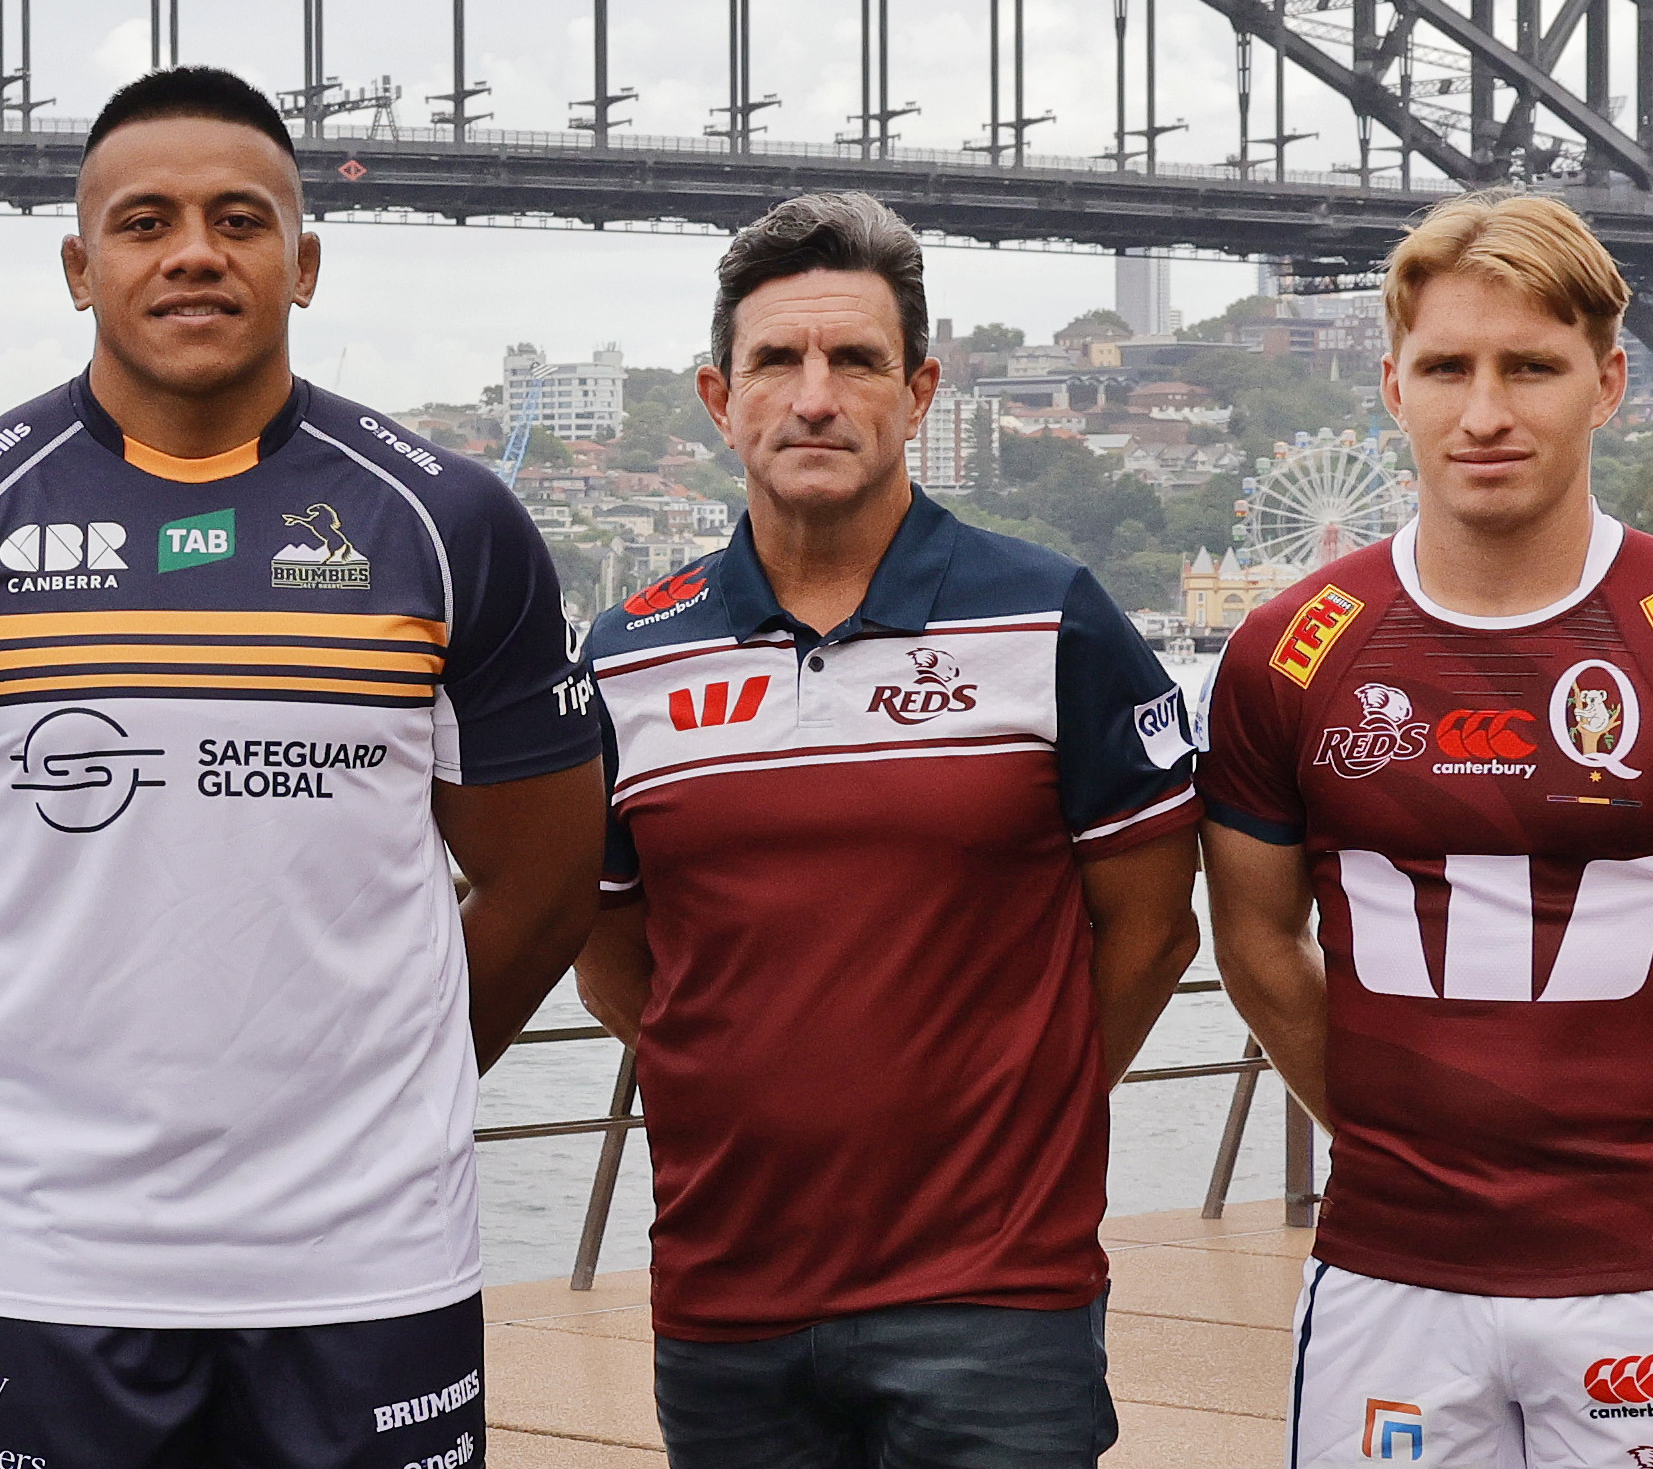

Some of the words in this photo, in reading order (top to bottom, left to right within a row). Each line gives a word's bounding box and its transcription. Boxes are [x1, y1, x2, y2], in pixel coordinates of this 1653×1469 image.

[166, 529, 229, 553] TAB
[7, 575, 119, 593] CANBERRA
[273, 566, 369, 583] BRUMBIES
[626, 587, 710, 631] canterbury
[1326, 591, 1355, 611] HIRE
[1282, 598, 1348, 669] TFH
[865, 684, 978, 726] REDS
[1139, 693, 1177, 737] QUT
[198, 739, 387, 769] SAFEGUARD
[1312, 722, 1431, 780] REDS
[197, 770, 333, 798] GLOBAL
[1432, 759, 1537, 780] canterbury
[374, 1369, 481, 1433] BRUMBIES
